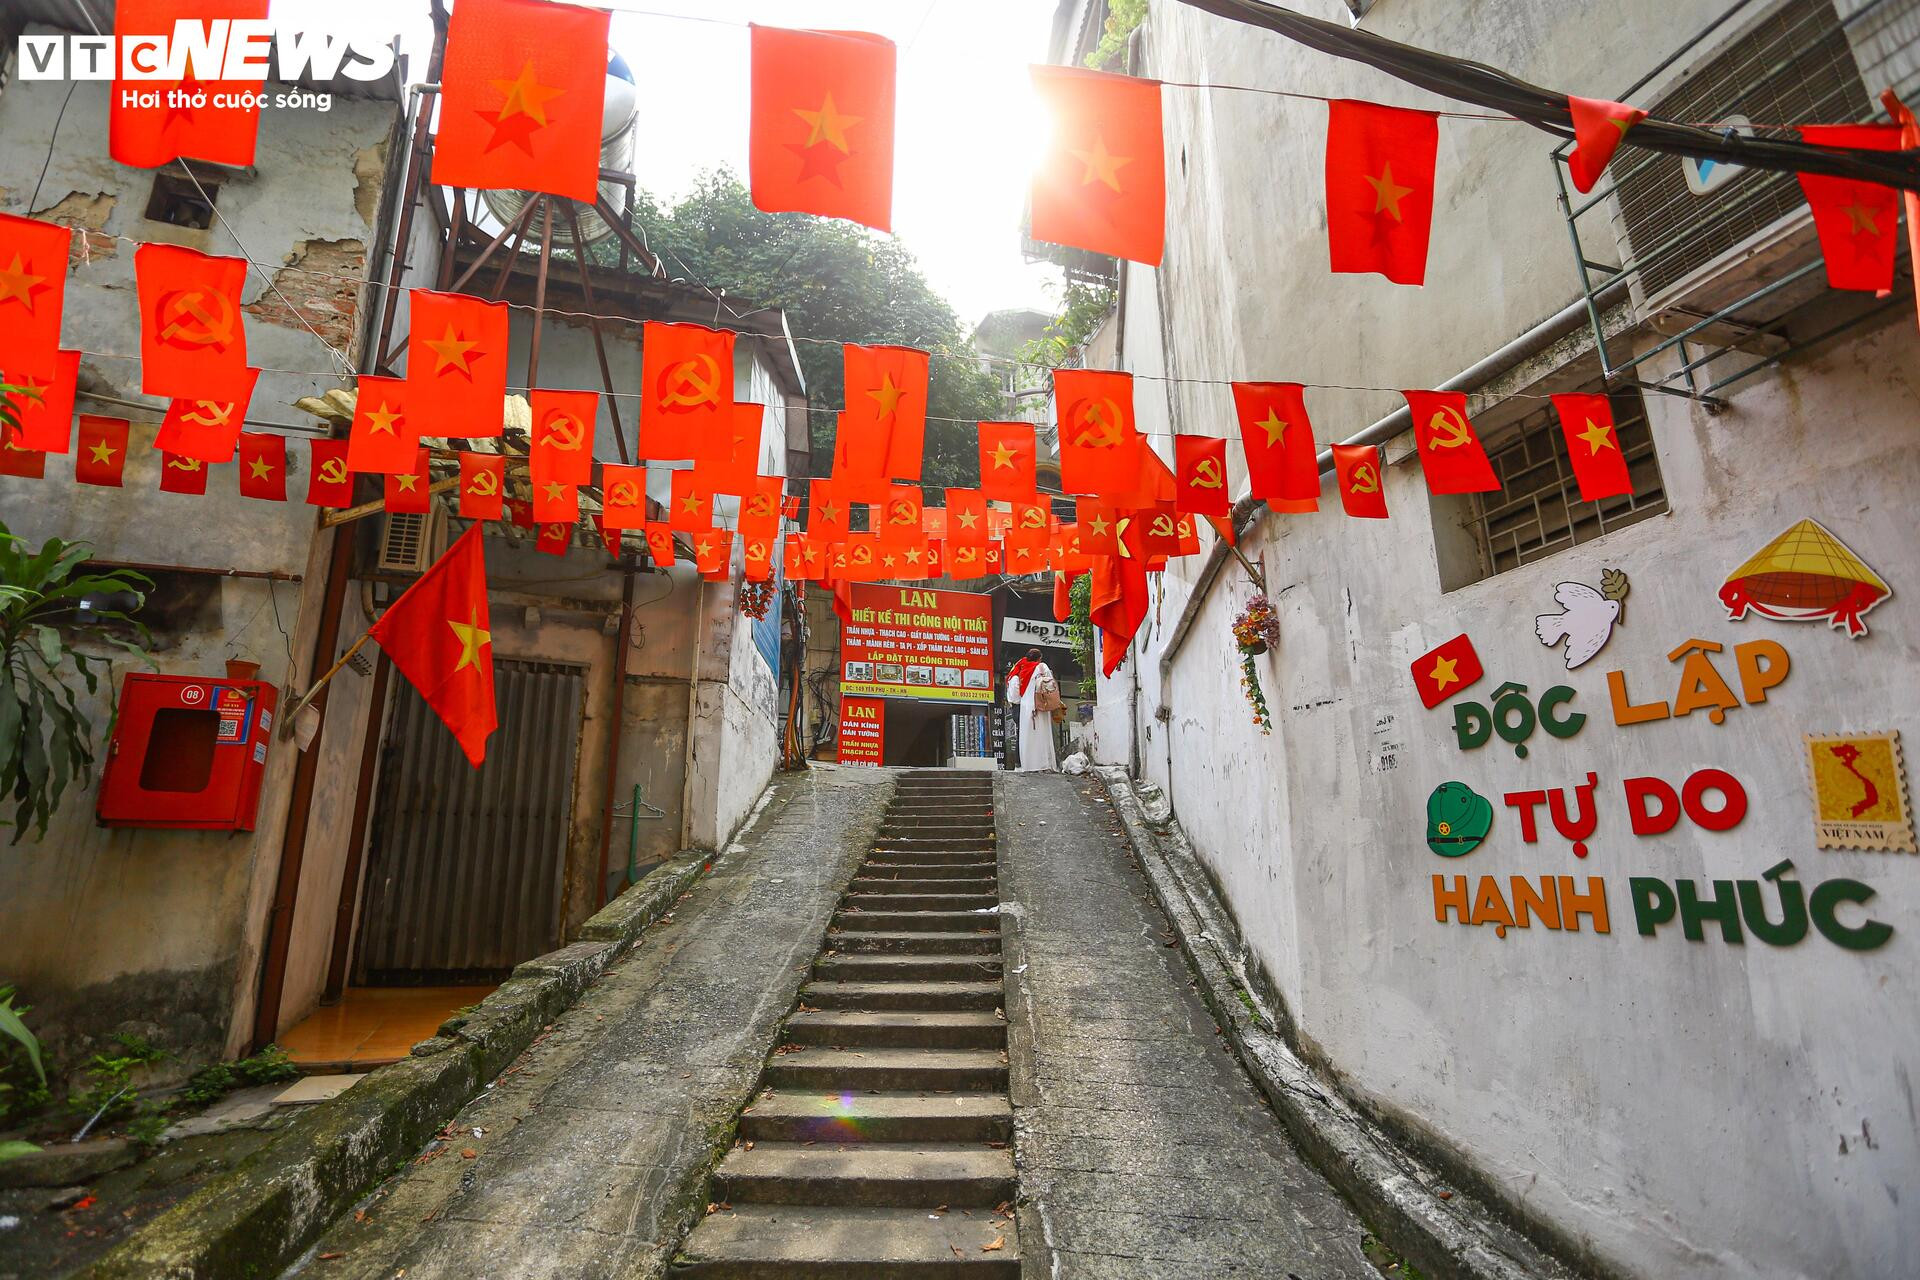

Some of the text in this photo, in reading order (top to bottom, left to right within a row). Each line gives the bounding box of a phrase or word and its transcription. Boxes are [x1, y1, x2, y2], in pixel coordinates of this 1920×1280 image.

[900, 589, 938, 609] LAN
[852, 607, 988, 632] HIẾT KẾ THI CÔNG NỘI THẤT
[896, 630, 906, 639] CAO
[1015, 620, 1049, 637] Diep
[904, 655, 918, 665] TẠI
[920, 655, 943, 666] CÔNG
[944, 657, 969, 667] TRÌNH
[186, 690, 199, 699] 08
[1452, 638, 1791, 759] ĐỘC LẬP
[848, 705, 876, 719] LAN
[865, 749, 879, 757] CAO
[1504, 768, 1748, 859] TỰ DO
[1854, 829, 1884, 840] NAM
[1431, 858, 1894, 952] HẠNH PHÚC
